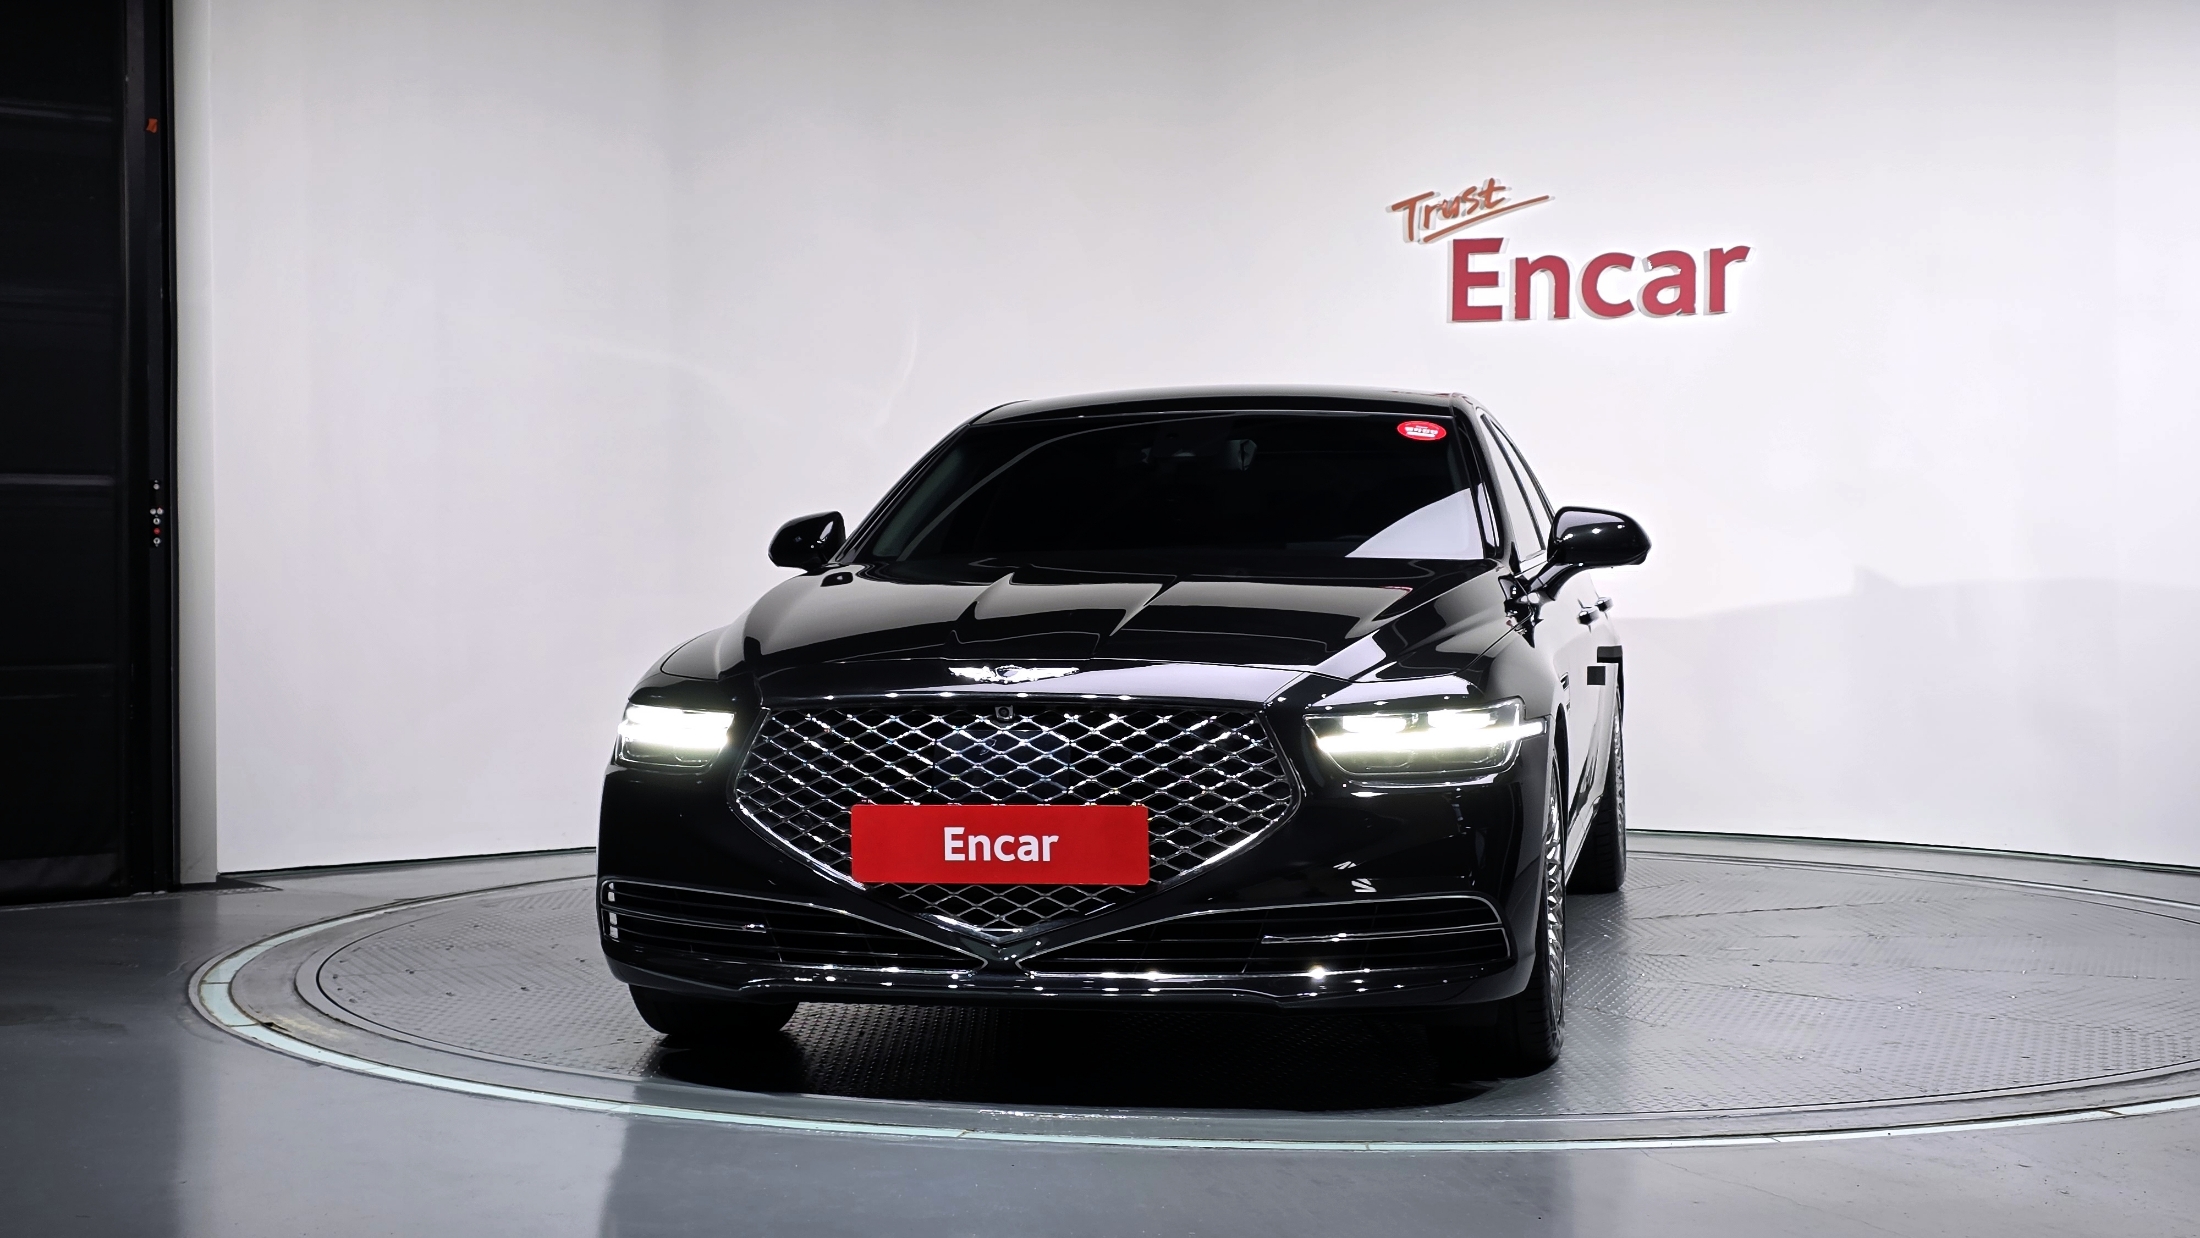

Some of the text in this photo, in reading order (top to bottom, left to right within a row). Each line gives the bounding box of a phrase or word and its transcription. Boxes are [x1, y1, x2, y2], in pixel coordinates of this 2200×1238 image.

[1391, 178, 1506, 242] Trust
[1452, 237, 1751, 322] Encar
[944, 827, 1059, 862] Encar
